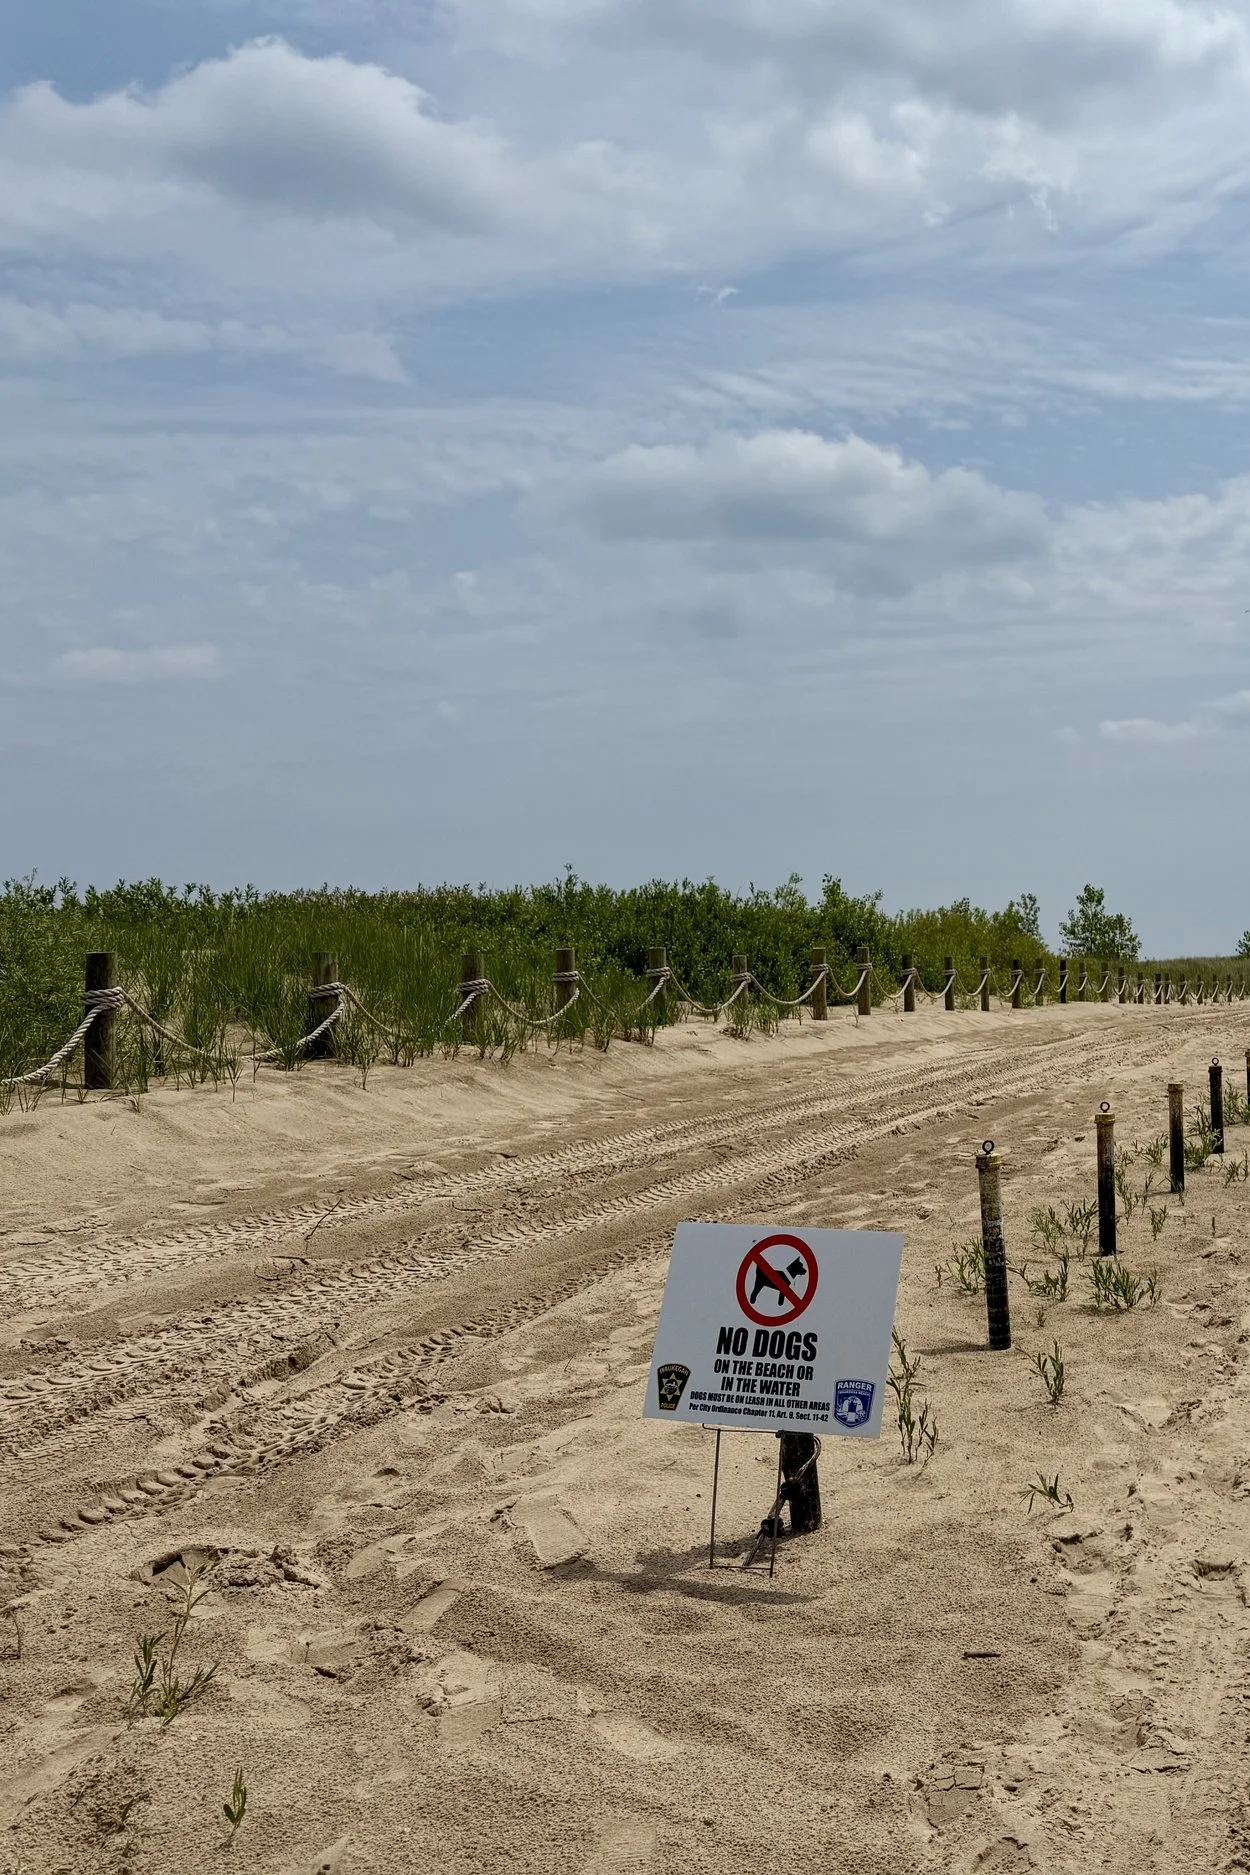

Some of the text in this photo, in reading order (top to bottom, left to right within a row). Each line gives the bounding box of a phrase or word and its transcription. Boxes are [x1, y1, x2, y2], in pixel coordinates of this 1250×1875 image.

[716, 1326, 818, 1362] NO DOGS
[659, 1365, 690, 1376] WAUKEGAN
[714, 1358, 814, 1381] ON THE BEACH OR
[720, 1376, 801, 1397] IN THE WATER
[837, 1381, 873, 1392] RANGER
[660, 1402, 676, 1410] POLICE
[690, 1391, 831, 1411] DOGS MUST BE ON LEASH IN ALL OTHER AREAS
[689, 1403, 699, 1411] Per
[699, 1403, 711, 1412] City
[711, 1404, 743, 1415] Ordinance
[743, 1407, 768, 1417] Chapter
[777, 1410, 787, 1418] Art.
[795, 1412, 811, 1420] Sect.
[813, 1413, 829, 1422] 11-42
